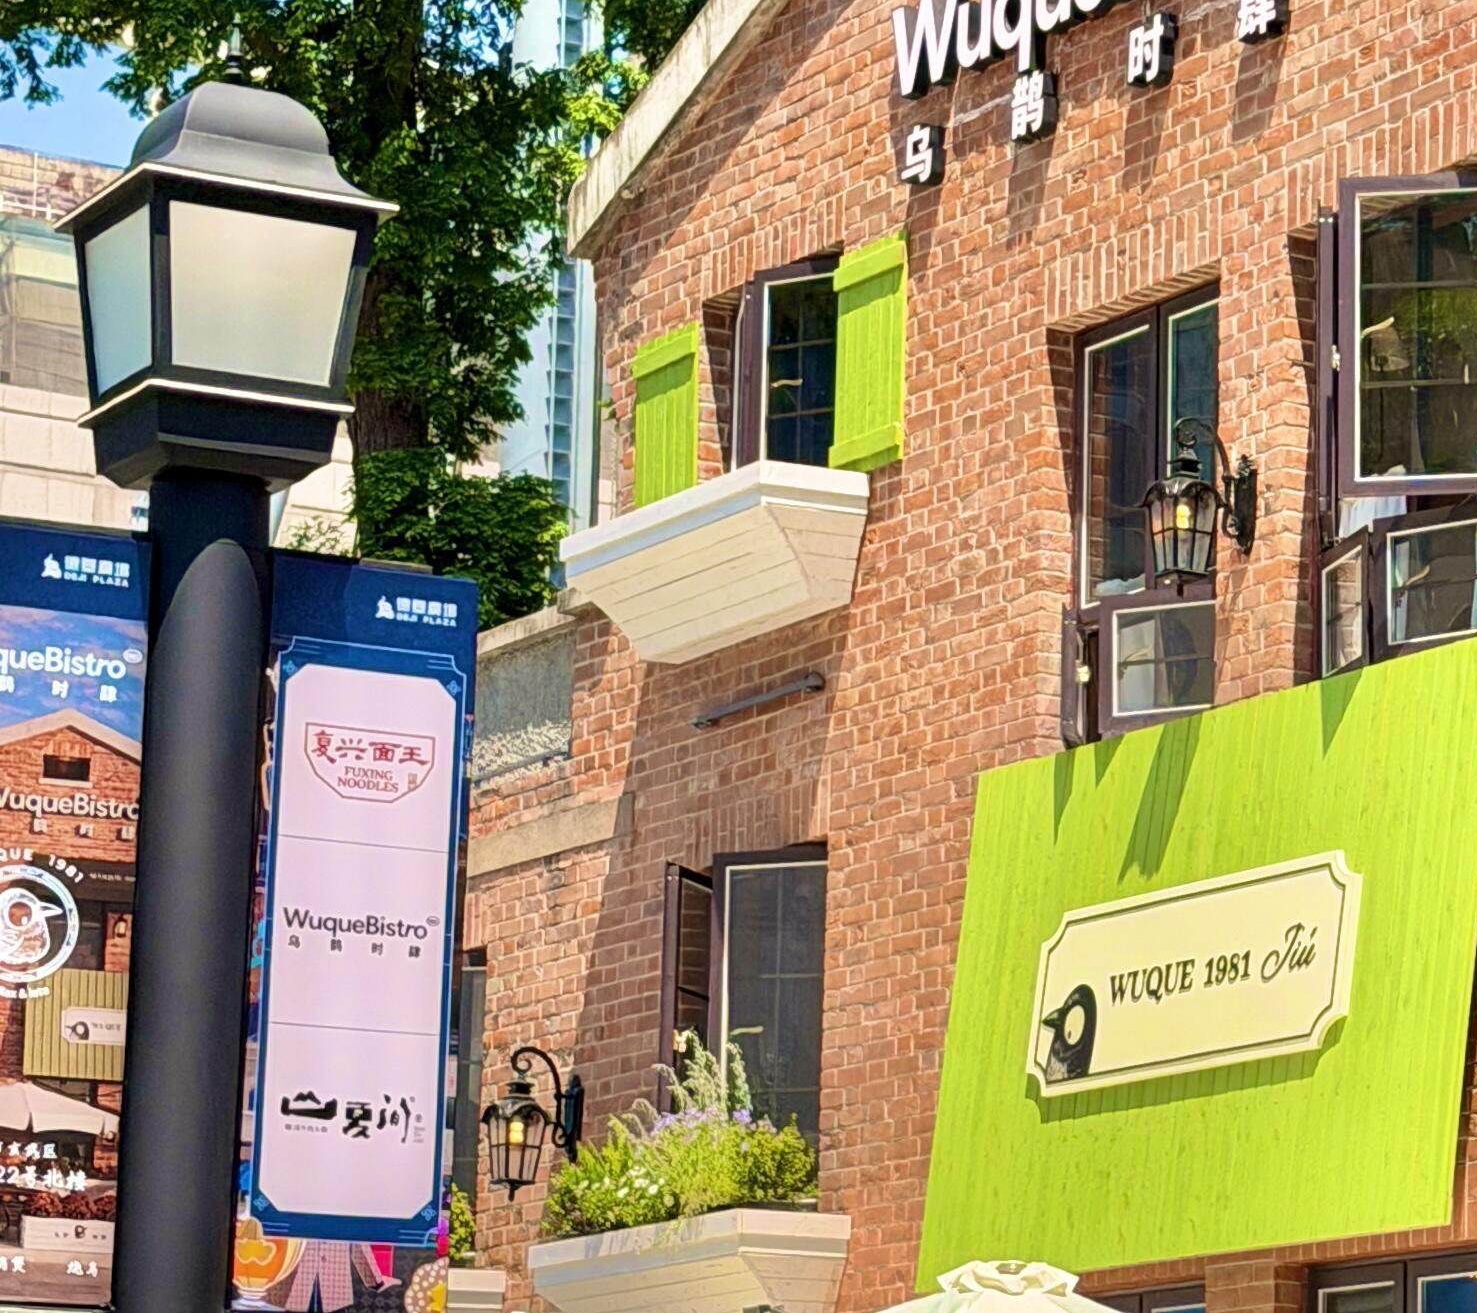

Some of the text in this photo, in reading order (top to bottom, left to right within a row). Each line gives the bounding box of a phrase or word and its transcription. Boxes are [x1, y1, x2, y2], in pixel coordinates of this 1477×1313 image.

[92, 574, 129, 588] PLAZA
[422, 615, 457, 627] PLAZA
[311, 729, 430, 766] 复兴面王
[337, 776, 399, 793] NOODLES
[344, 766, 393, 781] FUXING
[48, 853, 84, 883] 1981
[283, 907, 428, 940] WuqueBistro
[1110, 958, 1196, 1005] WUQUE
[1204, 949, 1251, 986] 1981
